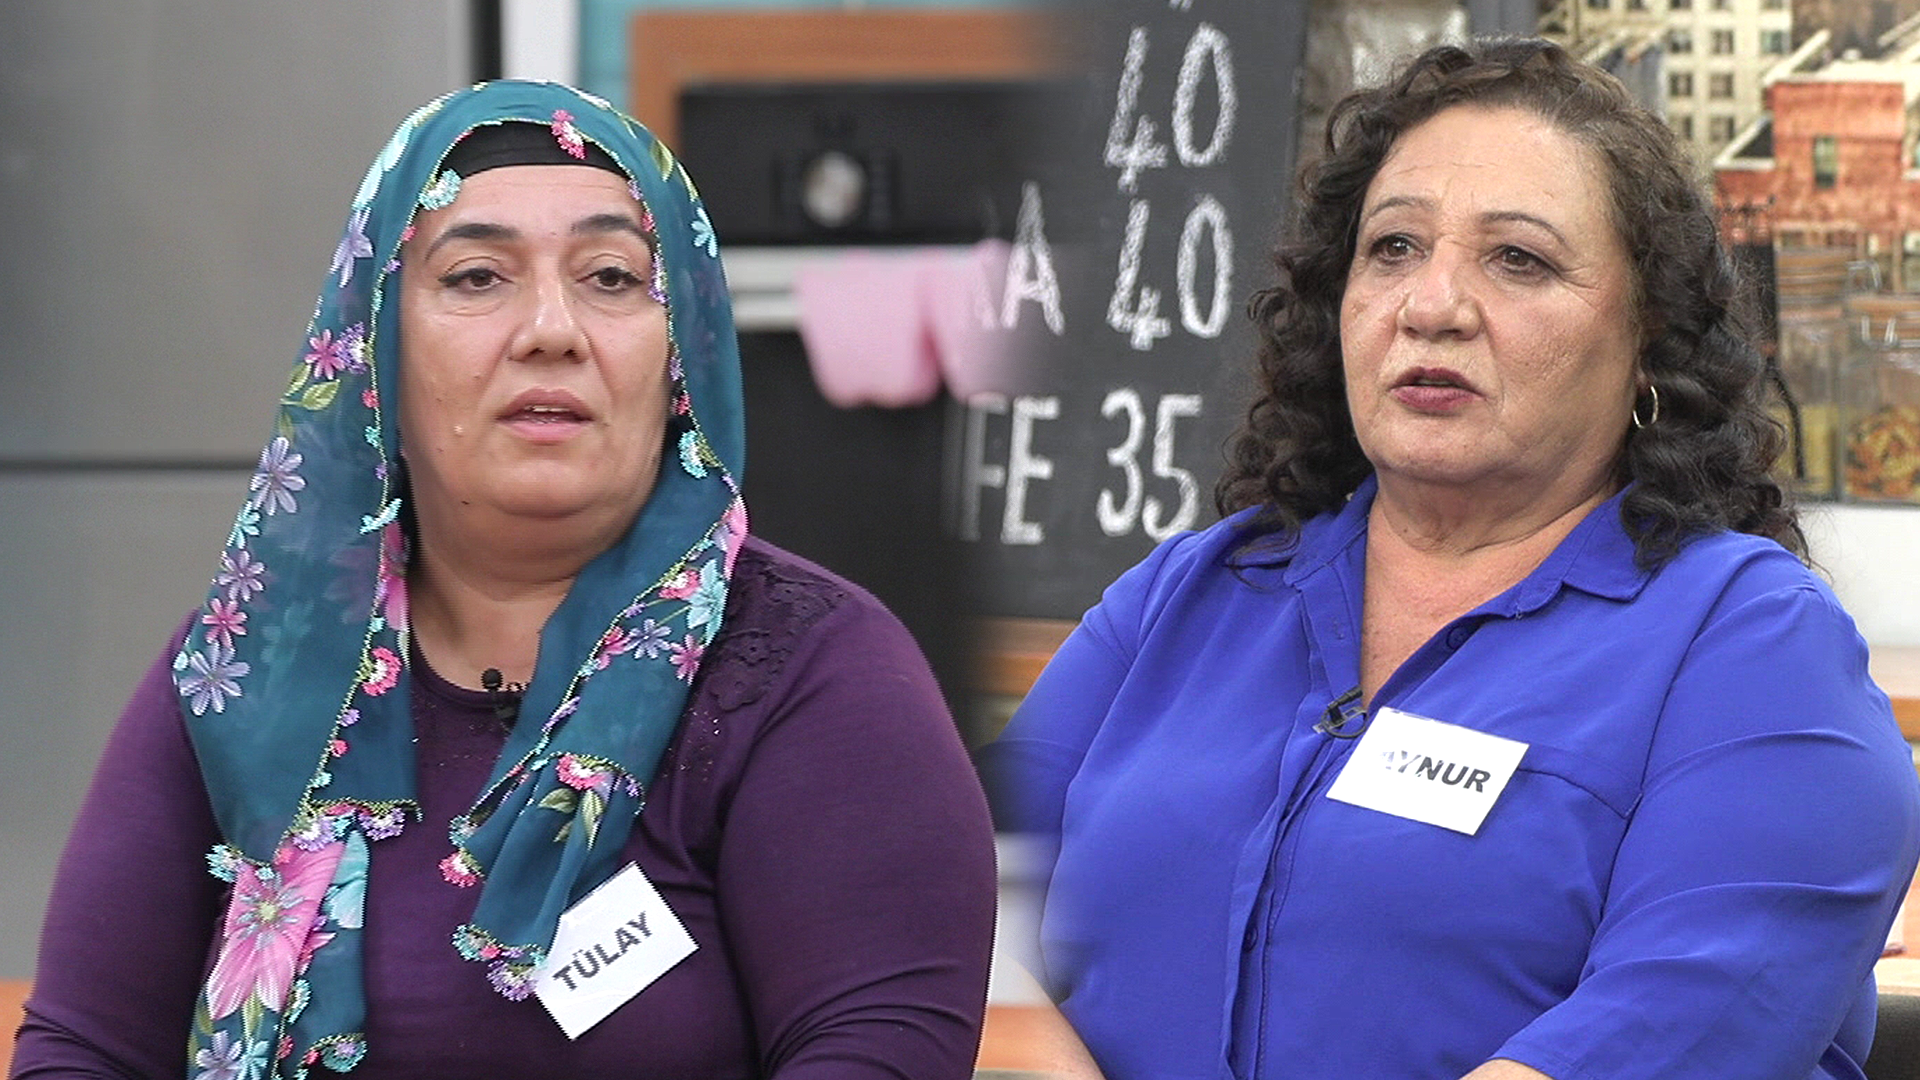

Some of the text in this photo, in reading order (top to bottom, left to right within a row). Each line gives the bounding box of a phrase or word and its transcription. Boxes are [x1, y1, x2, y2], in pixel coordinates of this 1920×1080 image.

[1103, 22, 1238, 195] 40
[978, 180, 1234, 350] A 40
[948, 388, 1202, 545] FE 35
[552, 911, 652, 990] TÜLAY
